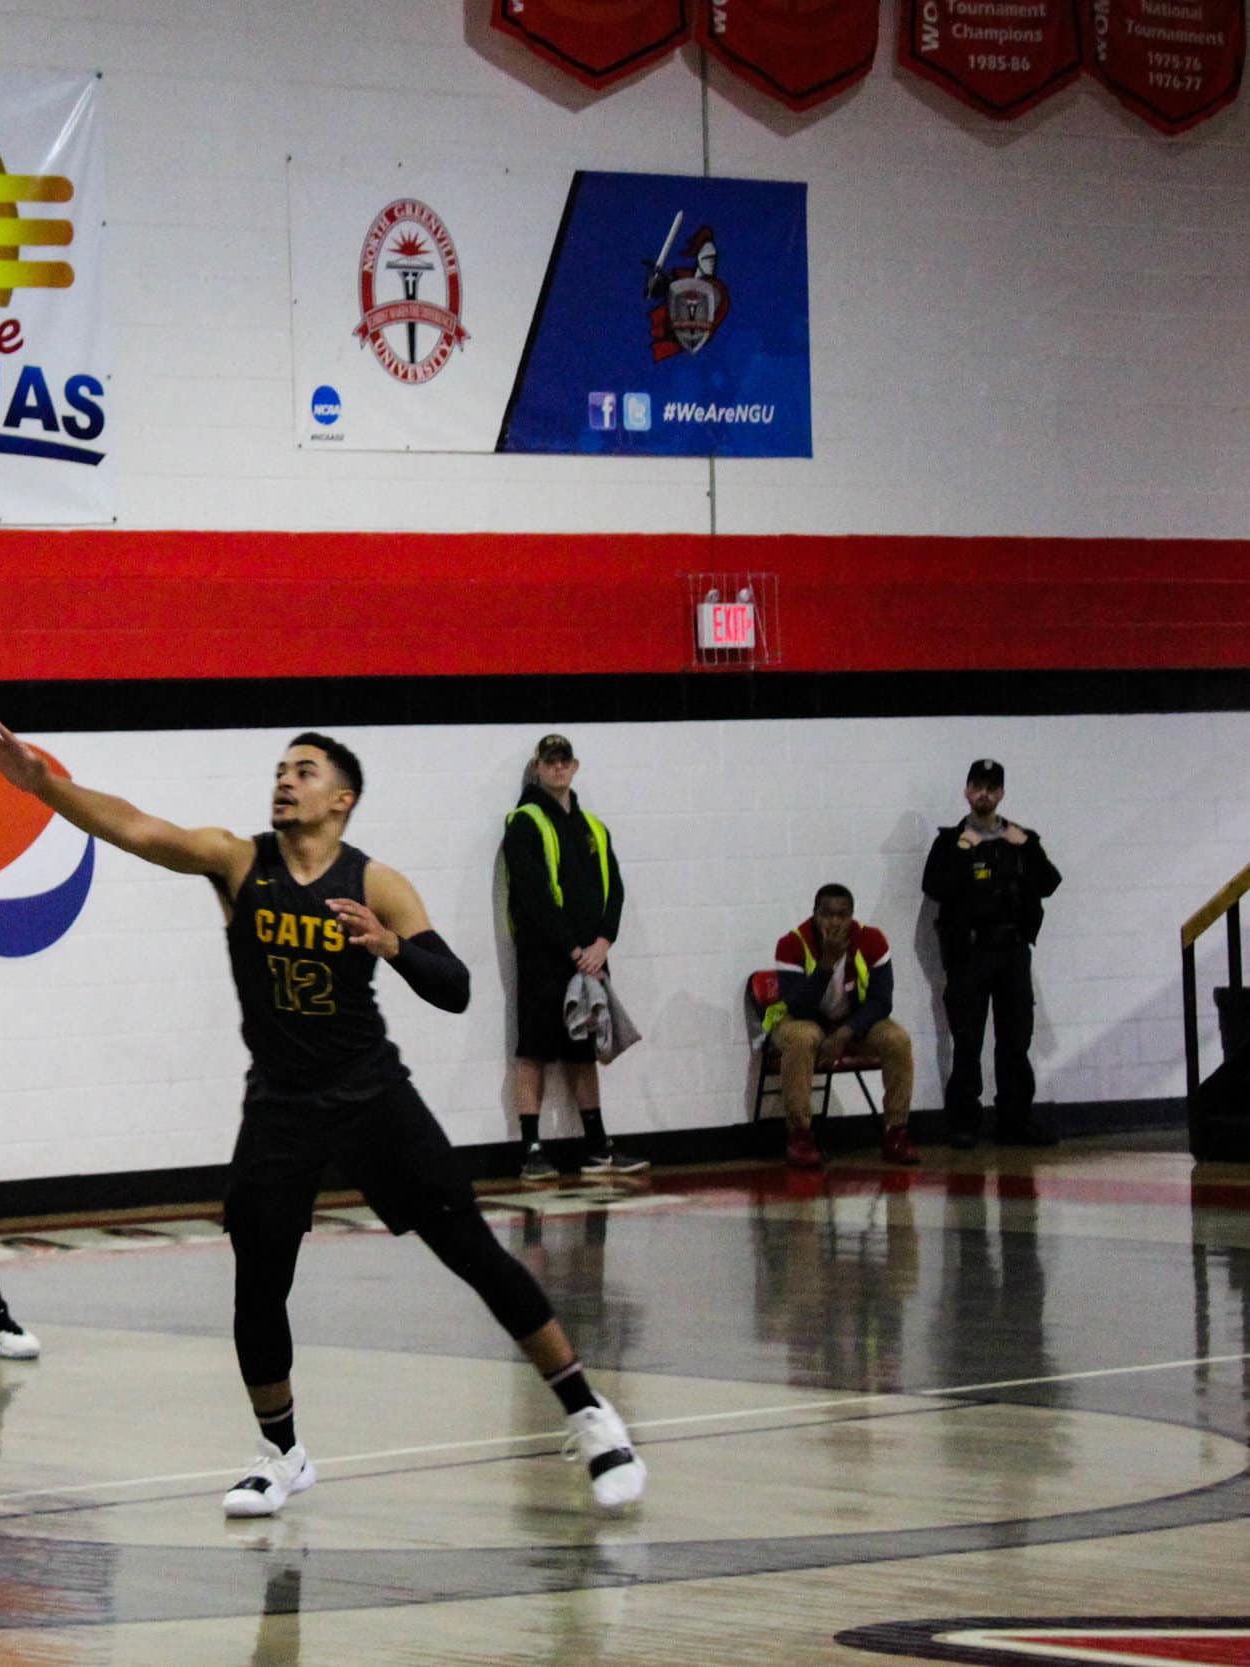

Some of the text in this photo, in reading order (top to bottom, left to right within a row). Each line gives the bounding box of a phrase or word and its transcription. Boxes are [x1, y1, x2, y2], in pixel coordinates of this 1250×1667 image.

[948, 0, 1047, 17] Tournament
[952, 23, 1043, 45] Champions
[968, 54, 1031, 71] 1985-86
[362, 202, 458, 275] NORTH GREENVILLE
[374, 336, 452, 382] UNIVERSITY
[663, 402, 775, 424] #WeAreNGU
[713, 606, 747, 643] EXIT
[256, 908, 345, 953] CATS
[267, 954, 337, 1016] 12
